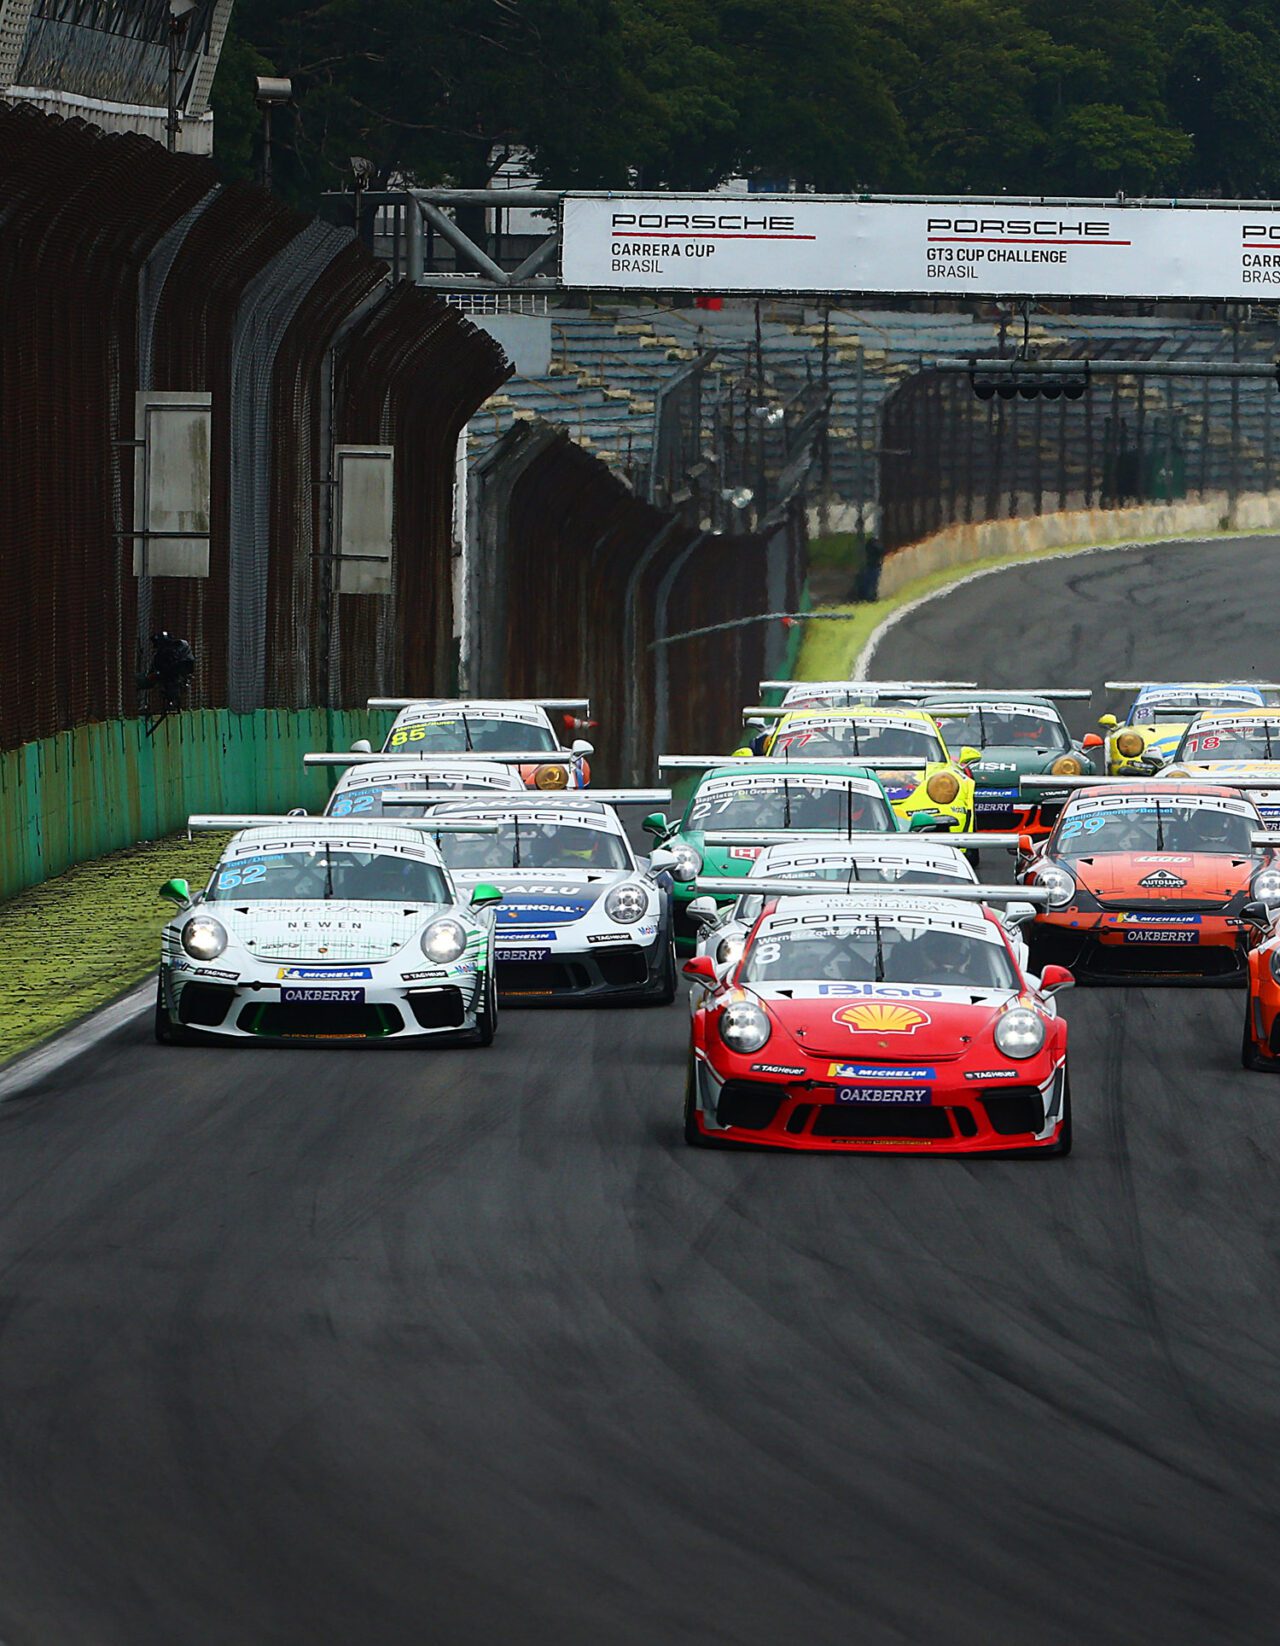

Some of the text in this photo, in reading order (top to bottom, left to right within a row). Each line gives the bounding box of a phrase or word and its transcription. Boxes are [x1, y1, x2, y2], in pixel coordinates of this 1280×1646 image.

[612, 214, 794, 231] PORSCHE
[928, 219, 1109, 235] PORSCHE
[612, 243, 715, 258] CARRERA CUP
[927, 247, 1067, 263] GT3 CUP CHALLENGE
[612, 259, 663, 273] BRASIL
[928, 265, 978, 279] BRASIL
[403, 711, 538, 724] PORSCHE
[788, 718, 927, 732] PORSCHE
[391, 728, 426, 747] 85
[779, 733, 813, 751] 77
[1186, 736, 1220, 753] 18
[348, 773, 511, 788] PORSCHE
[708, 778, 869, 791] PORSCHE
[331, 796, 375, 817] 32
[693, 798, 734, 820] 27
[1077, 798, 1245, 813] PORSCHE
[1061, 817, 1106, 840] 29
[235, 841, 426, 858] PORSCHE
[767, 857, 958, 872] PORSCHE
[218, 865, 267, 890] 52
[288, 921, 362, 929] NEWEN
[770, 914, 987, 935] PORSCHE
[1127, 931, 1195, 942] OAKBERRY
[754, 943, 781, 965] 8
[285, 990, 361, 1002] OAKBERRY
[858, 1069, 927, 1077] MICHELIN
[840, 1089, 927, 1102] OAKBERRY
